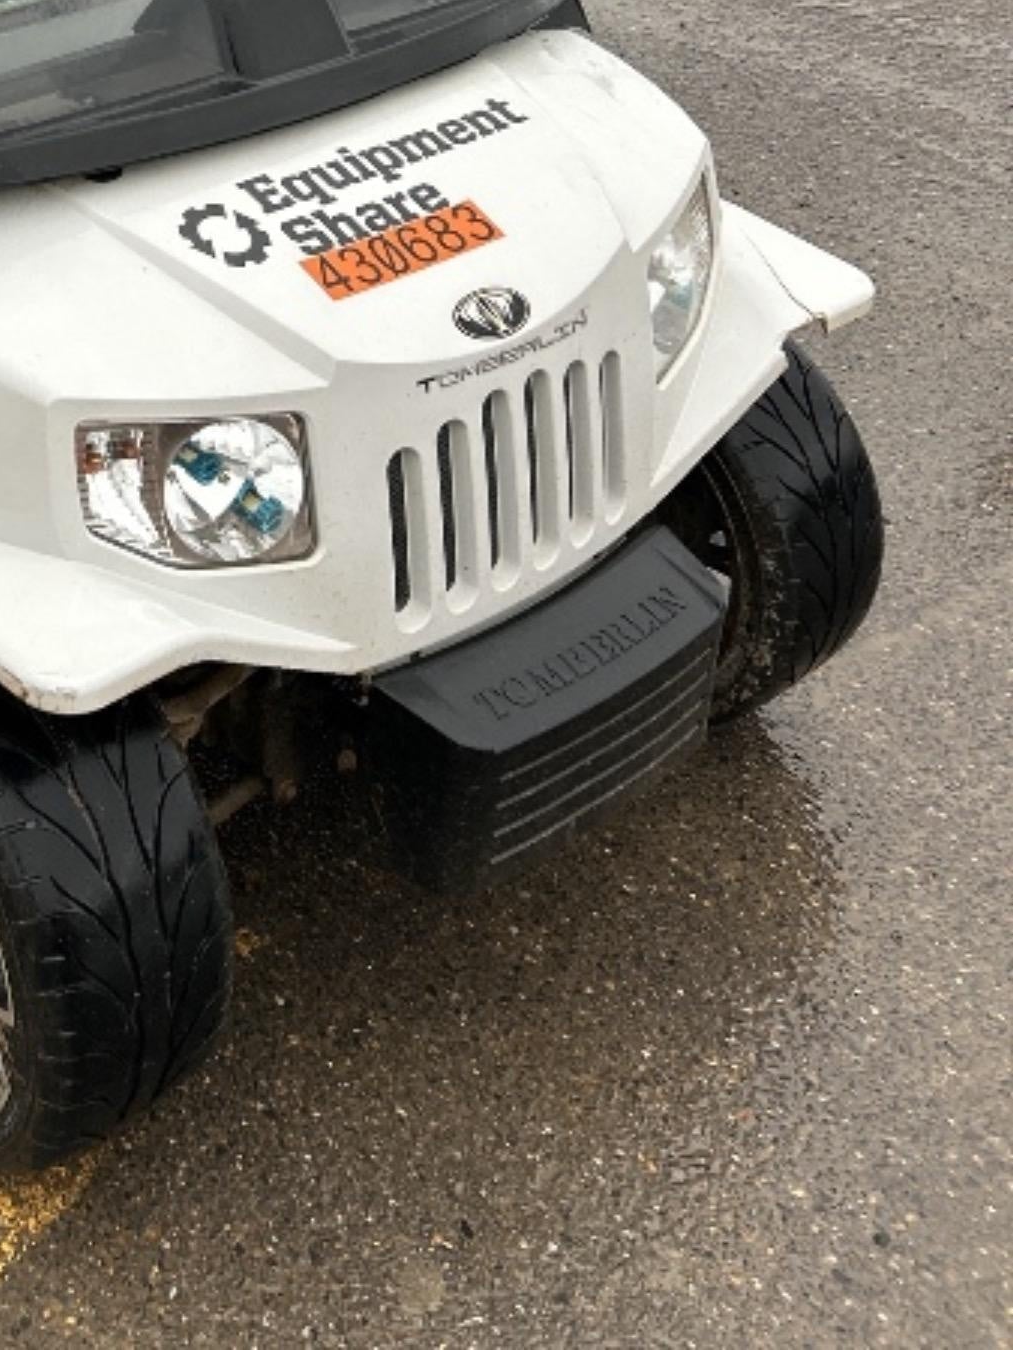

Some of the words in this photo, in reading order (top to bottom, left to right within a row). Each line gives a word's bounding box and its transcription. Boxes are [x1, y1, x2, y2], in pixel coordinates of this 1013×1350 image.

[237, 98, 529, 213] Equipment
[280, 182, 450, 256] Share
[316, 204, 496, 292] 430683
[472, 586, 687, 721] TOMBERLIN
